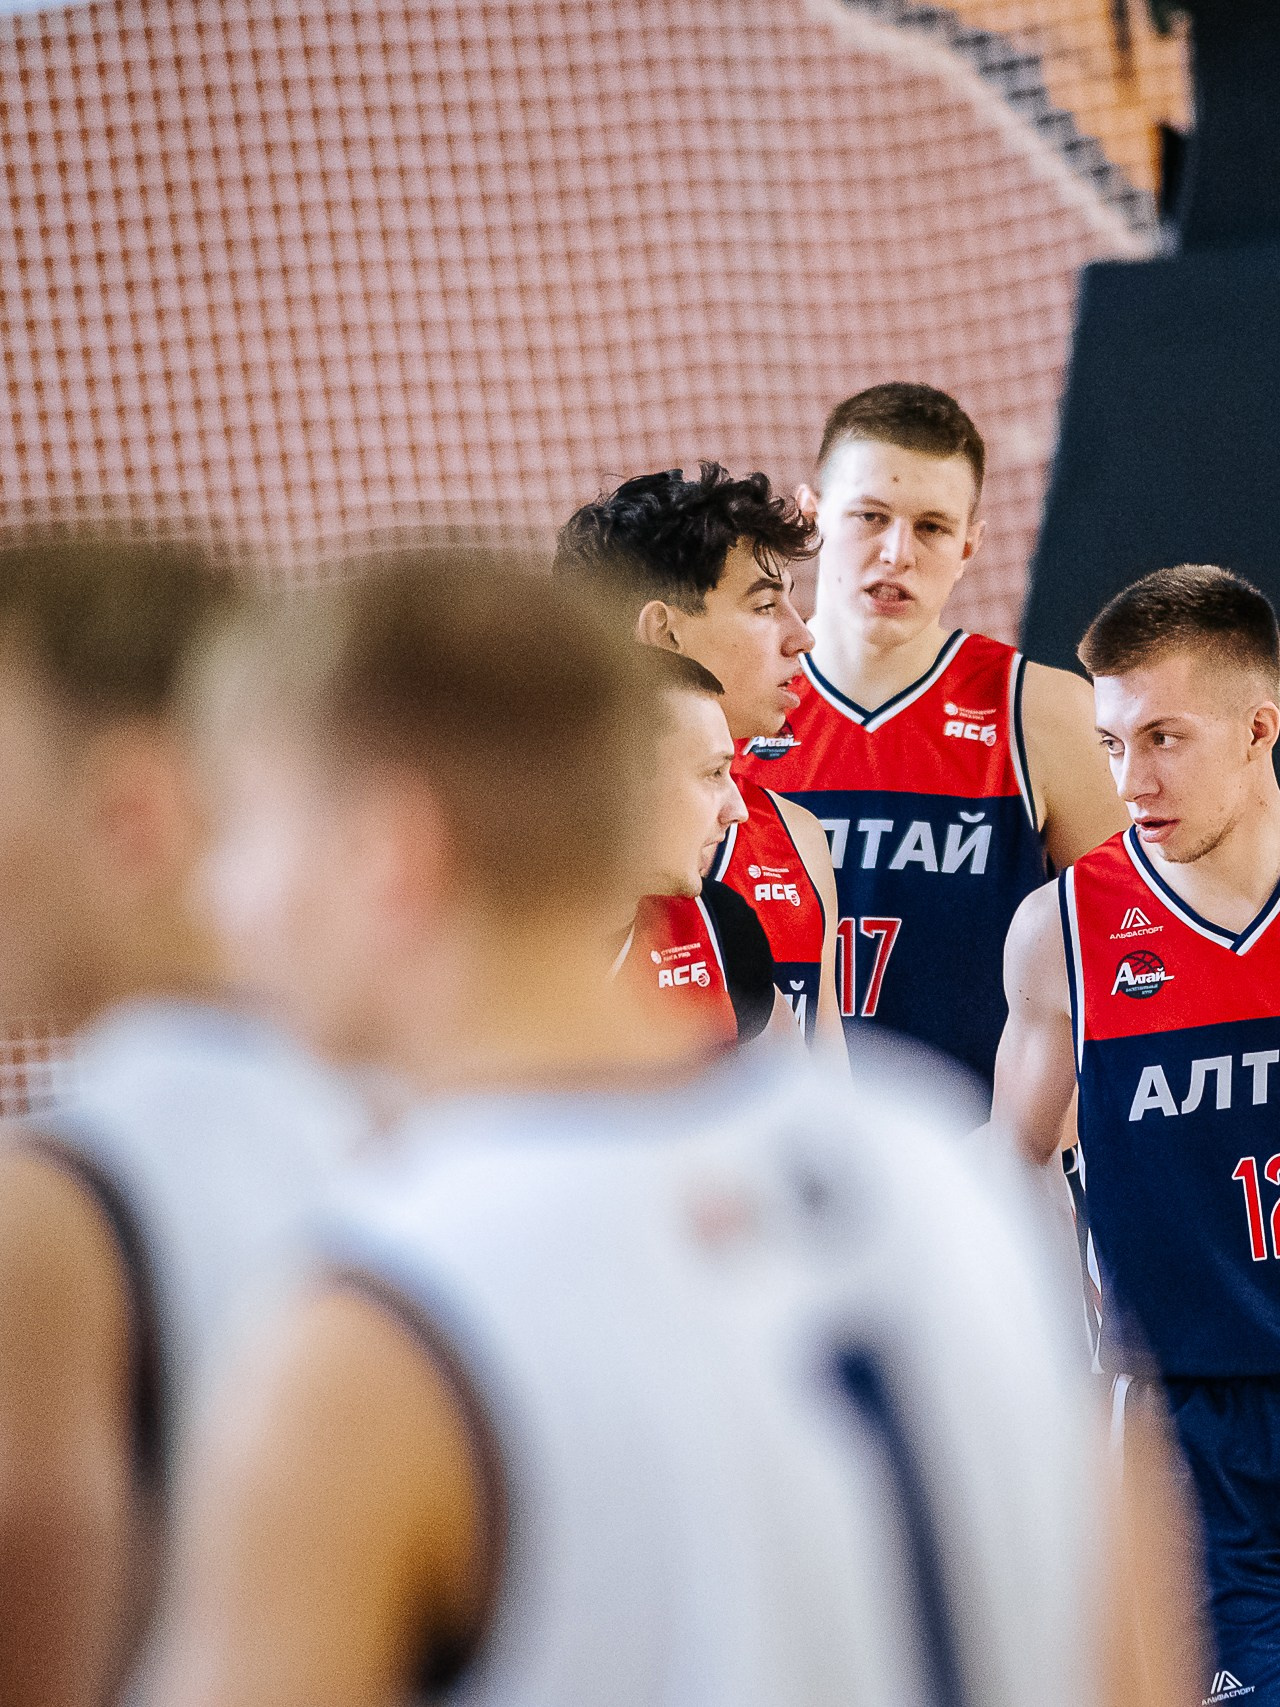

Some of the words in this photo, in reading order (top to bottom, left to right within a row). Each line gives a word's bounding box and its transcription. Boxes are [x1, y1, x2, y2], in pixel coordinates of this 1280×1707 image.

[944, 720, 997, 747] АСБ
[819, 811, 993, 875] ЛТАЙ
[754, 883, 801, 907] АСБ
[1109, 925, 1164, 940] АЛЬФАСПОРТ
[658, 961, 711, 988] АСБ
[836, 916, 903, 1018] 17
[1110, 962, 1175, 996] Алтай
